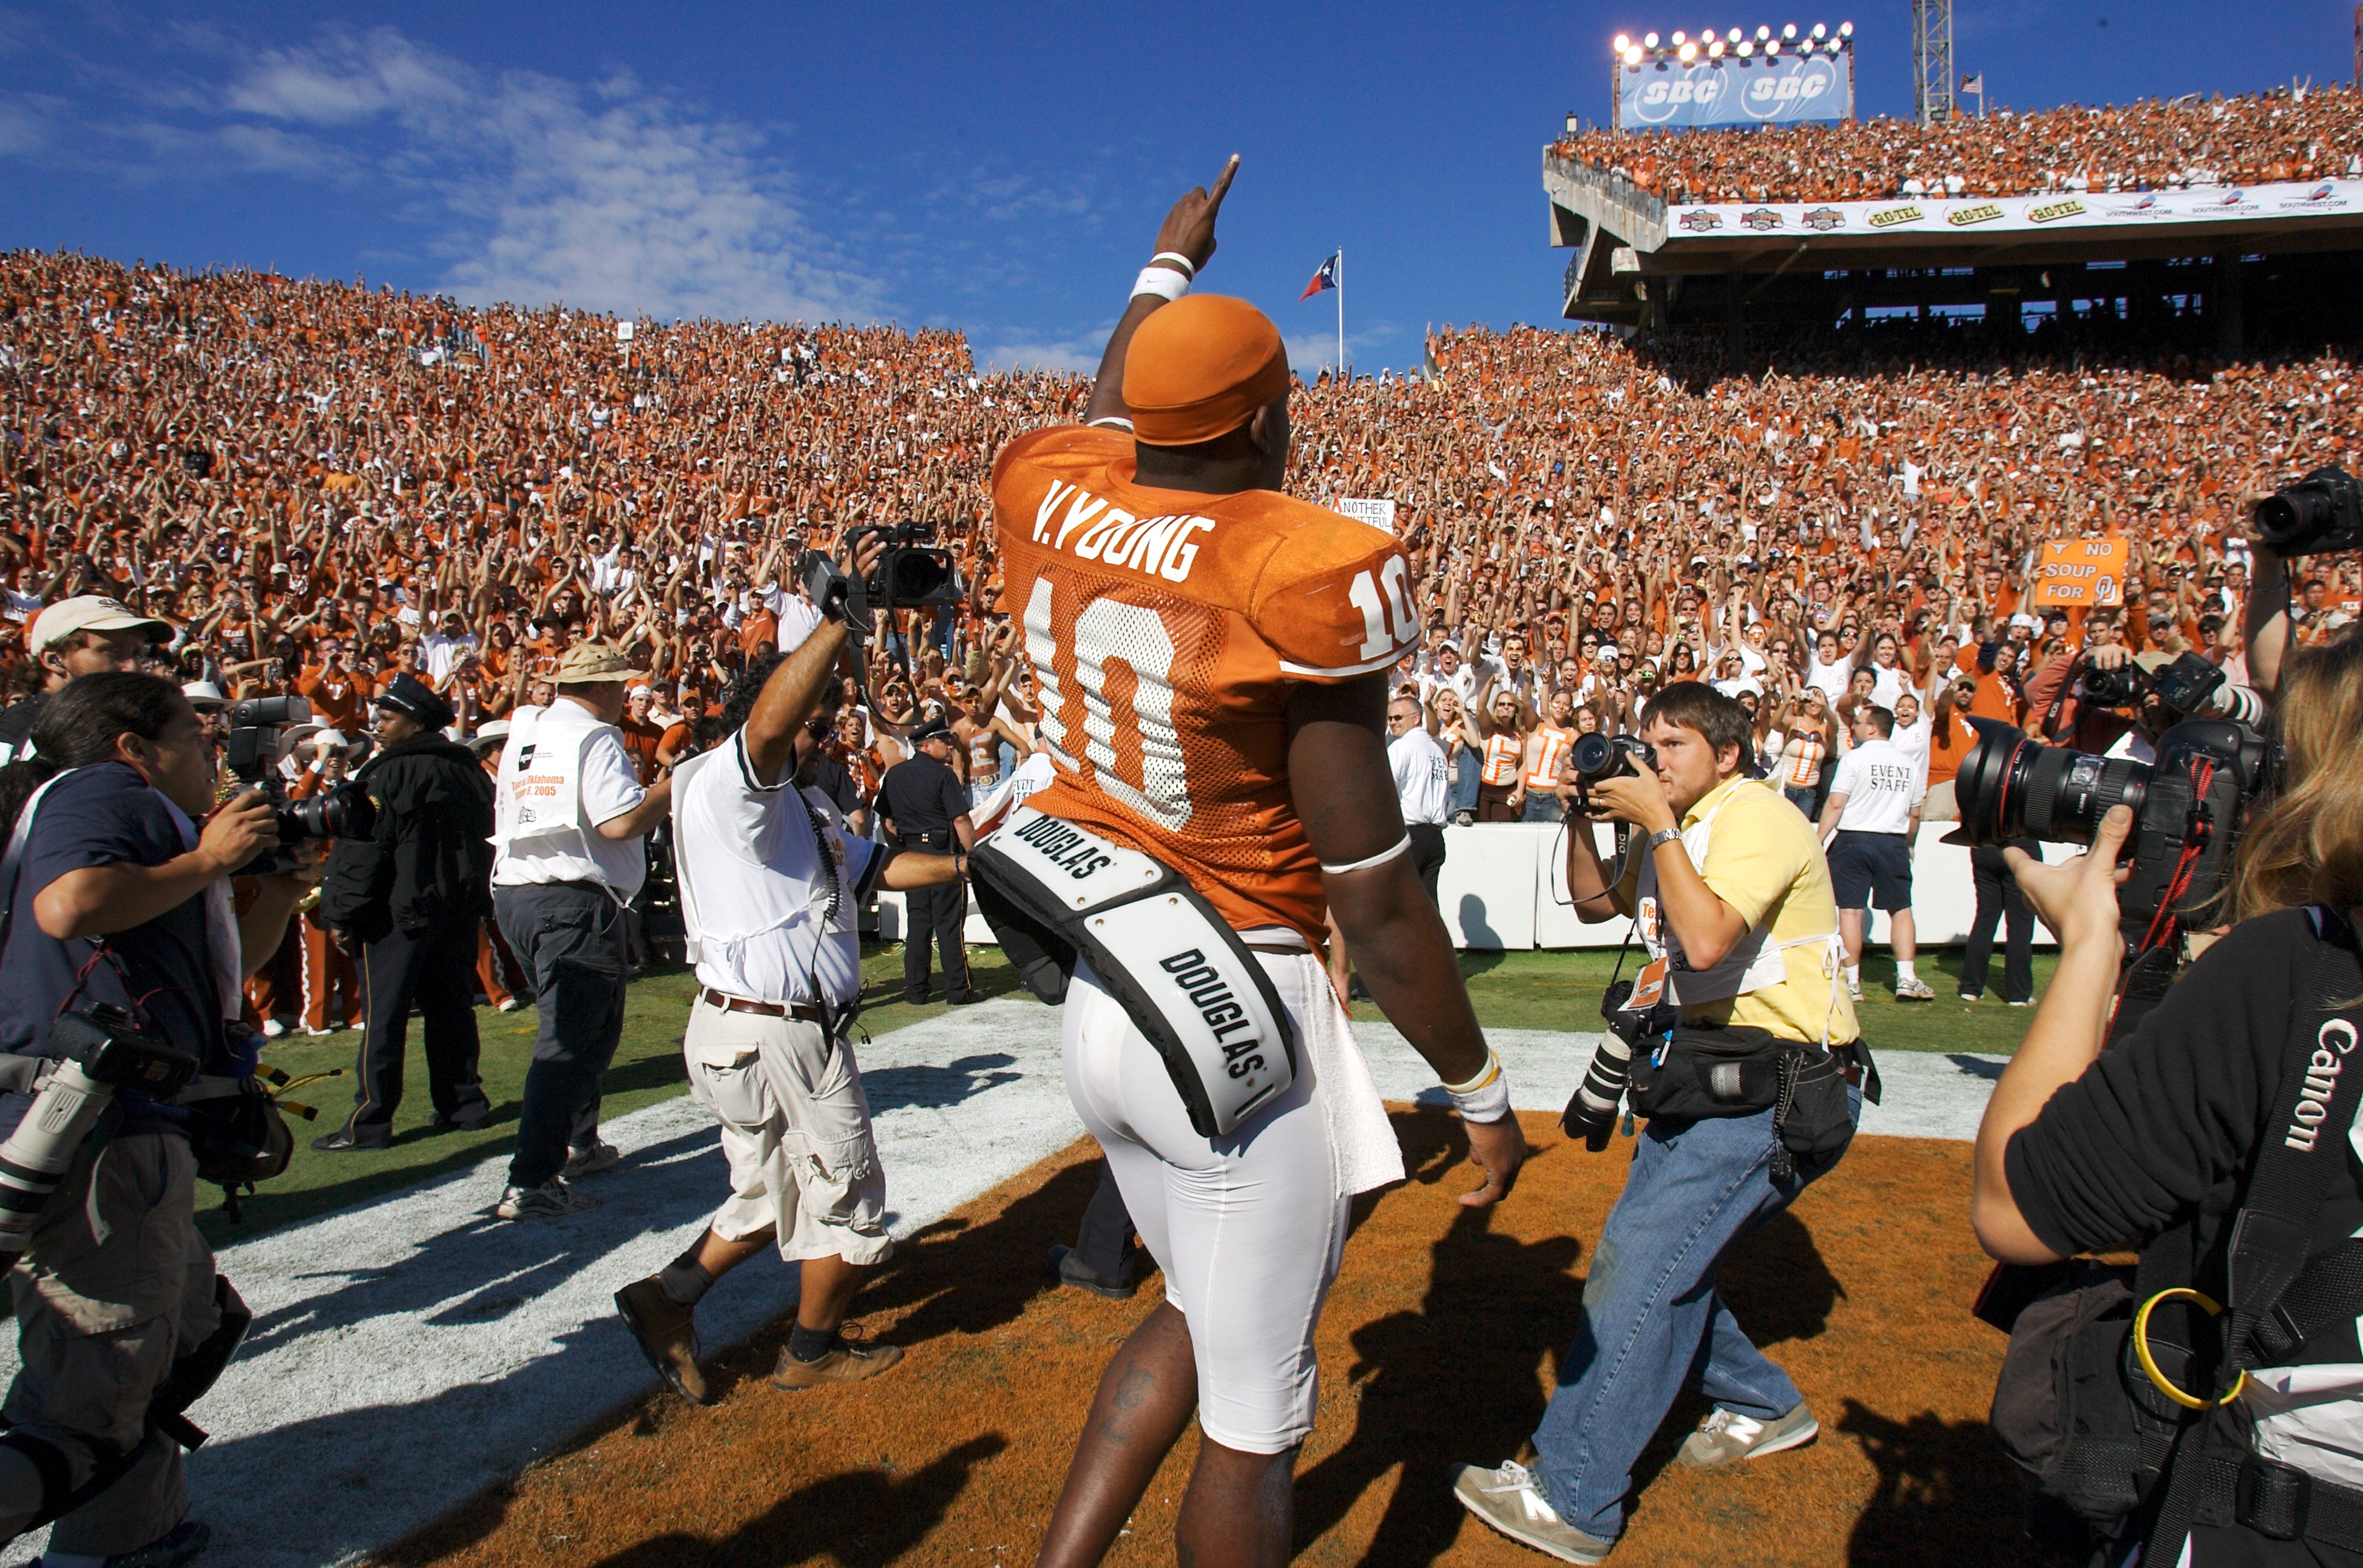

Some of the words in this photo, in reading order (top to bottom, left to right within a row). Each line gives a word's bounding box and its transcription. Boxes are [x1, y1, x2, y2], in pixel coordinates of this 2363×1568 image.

[1643, 79, 1719, 105] SBC
[1751, 74, 1826, 101] SBC
[2192, 204, 2259, 213] SOUTHWEST.COM
[2279, 200, 2347, 209] SOUTHWEST.COM
[2106, 209, 2172, 217] SOUTHWEST.COM
[2086, 542, 2112, 556] NO
[2045, 563, 2097, 578] SOUP
[2047, 585, 2084, 599] FOR
[1348, 553, 1419, 661] 10
[1023, 576, 1192, 833] 10
[970, 732, 994, 768] E
[1870, 765, 1910, 779] EVENT
[534, 786, 556, 796] 2005
[1870, 778, 1909, 792] STAFF
[1014, 815, 1111, 879] DOUGLAS
[1159, 948, 1265, 1079] DOUGLAS
[2285, 1018, 2358, 1152] Canon
